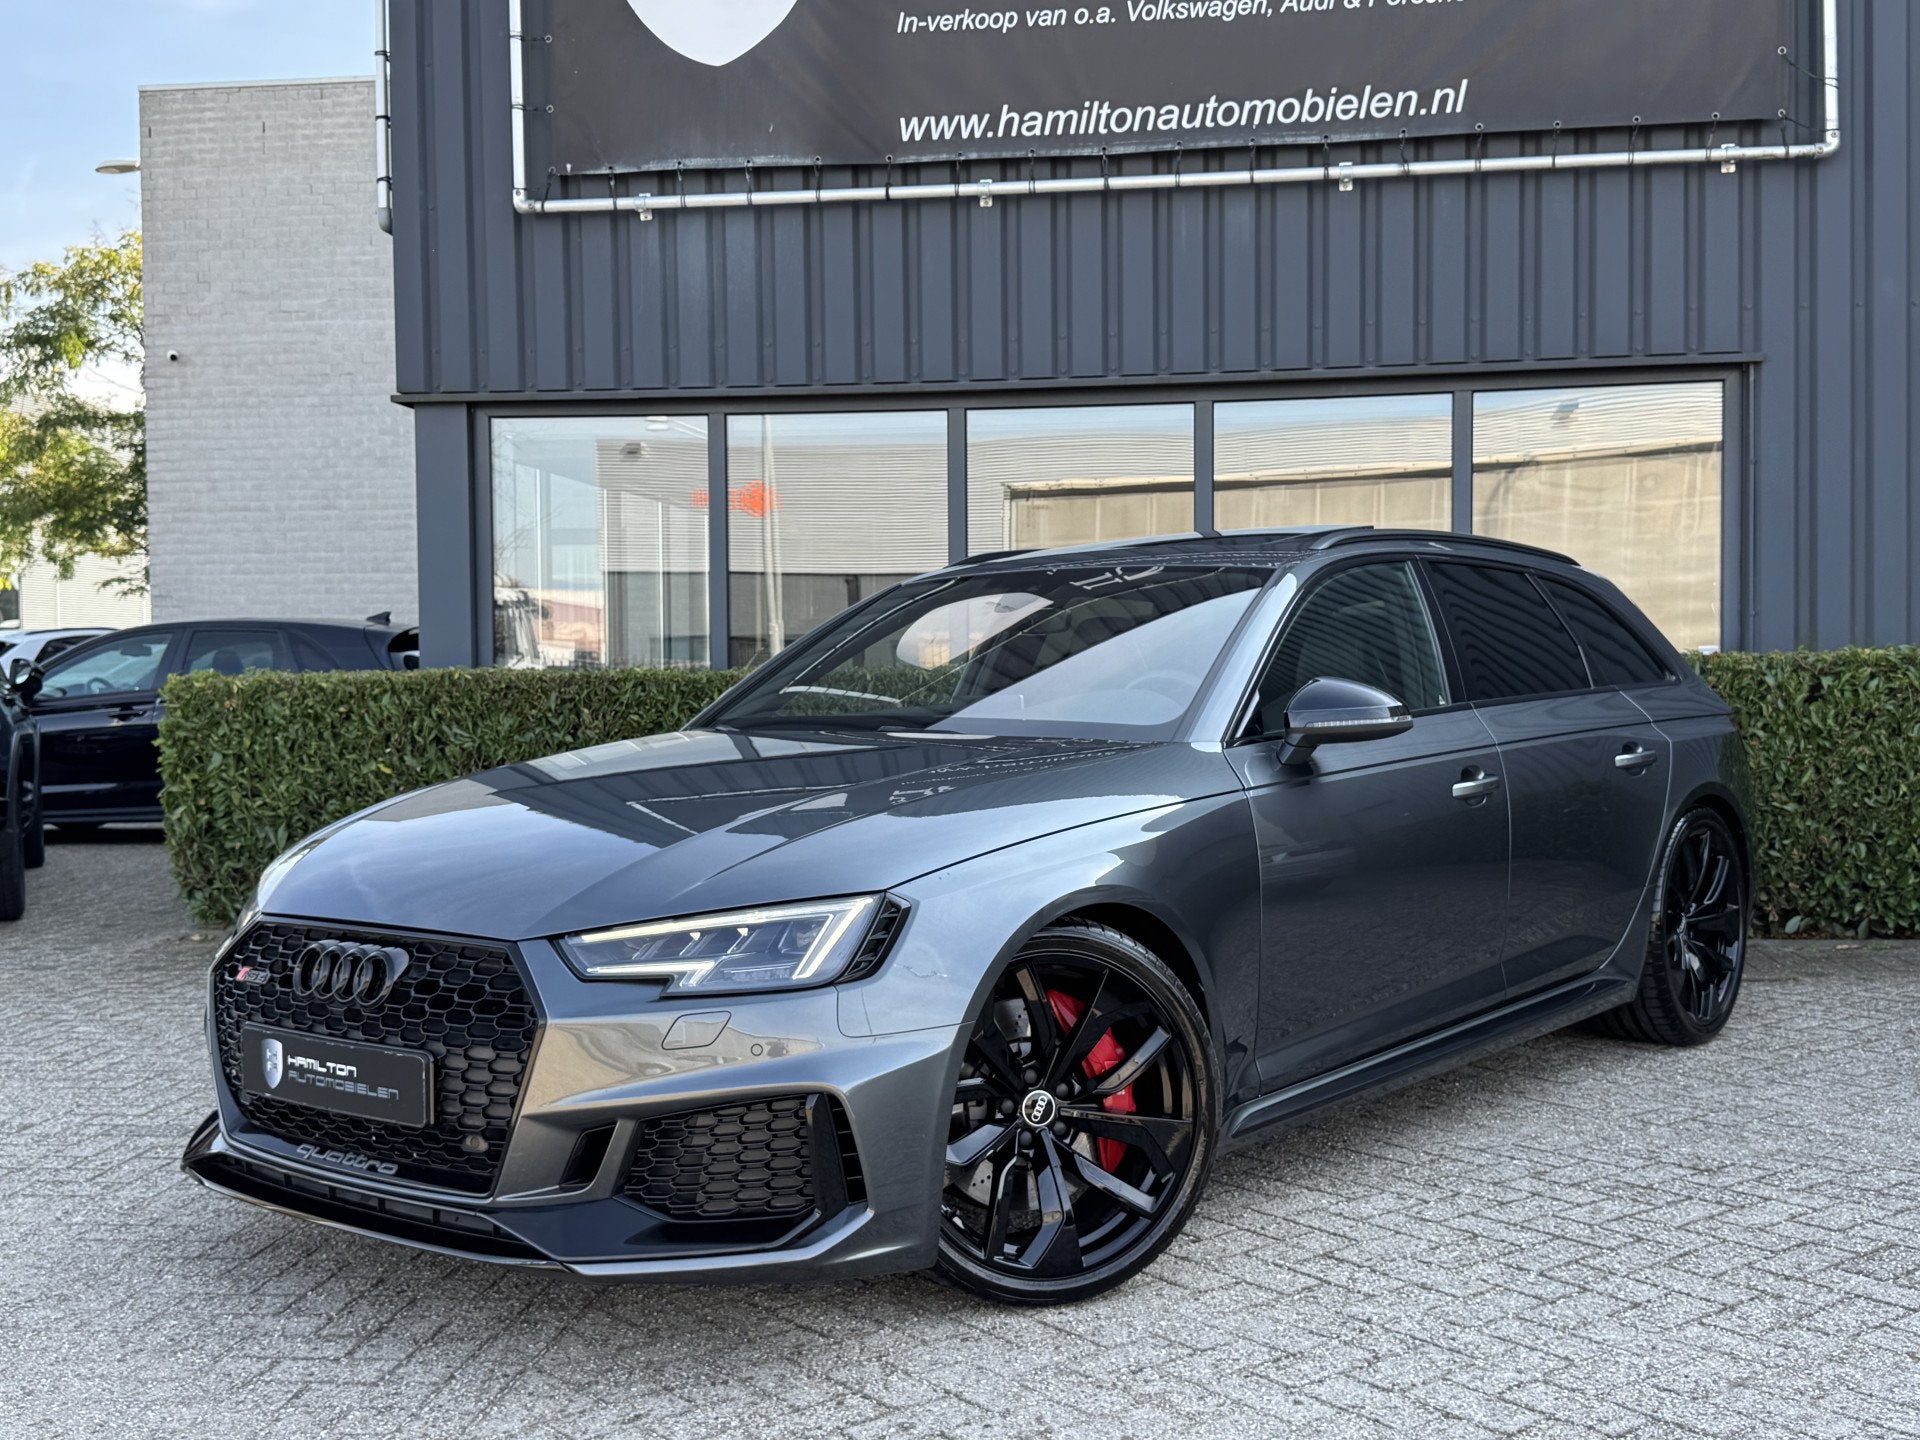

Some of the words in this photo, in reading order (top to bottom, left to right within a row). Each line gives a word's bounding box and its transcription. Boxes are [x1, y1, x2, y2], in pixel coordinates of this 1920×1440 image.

[897, 8, 1019, 34] In-verkoop
[1026, 8, 1067, 28] van
[1074, 7, 1116, 25] o.a.
[1127, 0, 1273, 22] Volkswagen,
[899, 79, 1468, 141] www.hamiltonautomobielen.nl
[287, 1054, 357, 1078] HAMILTON
[287, 1070, 399, 1100] AUTOMOBIELEN
[296, 1142, 399, 1175] quattro
